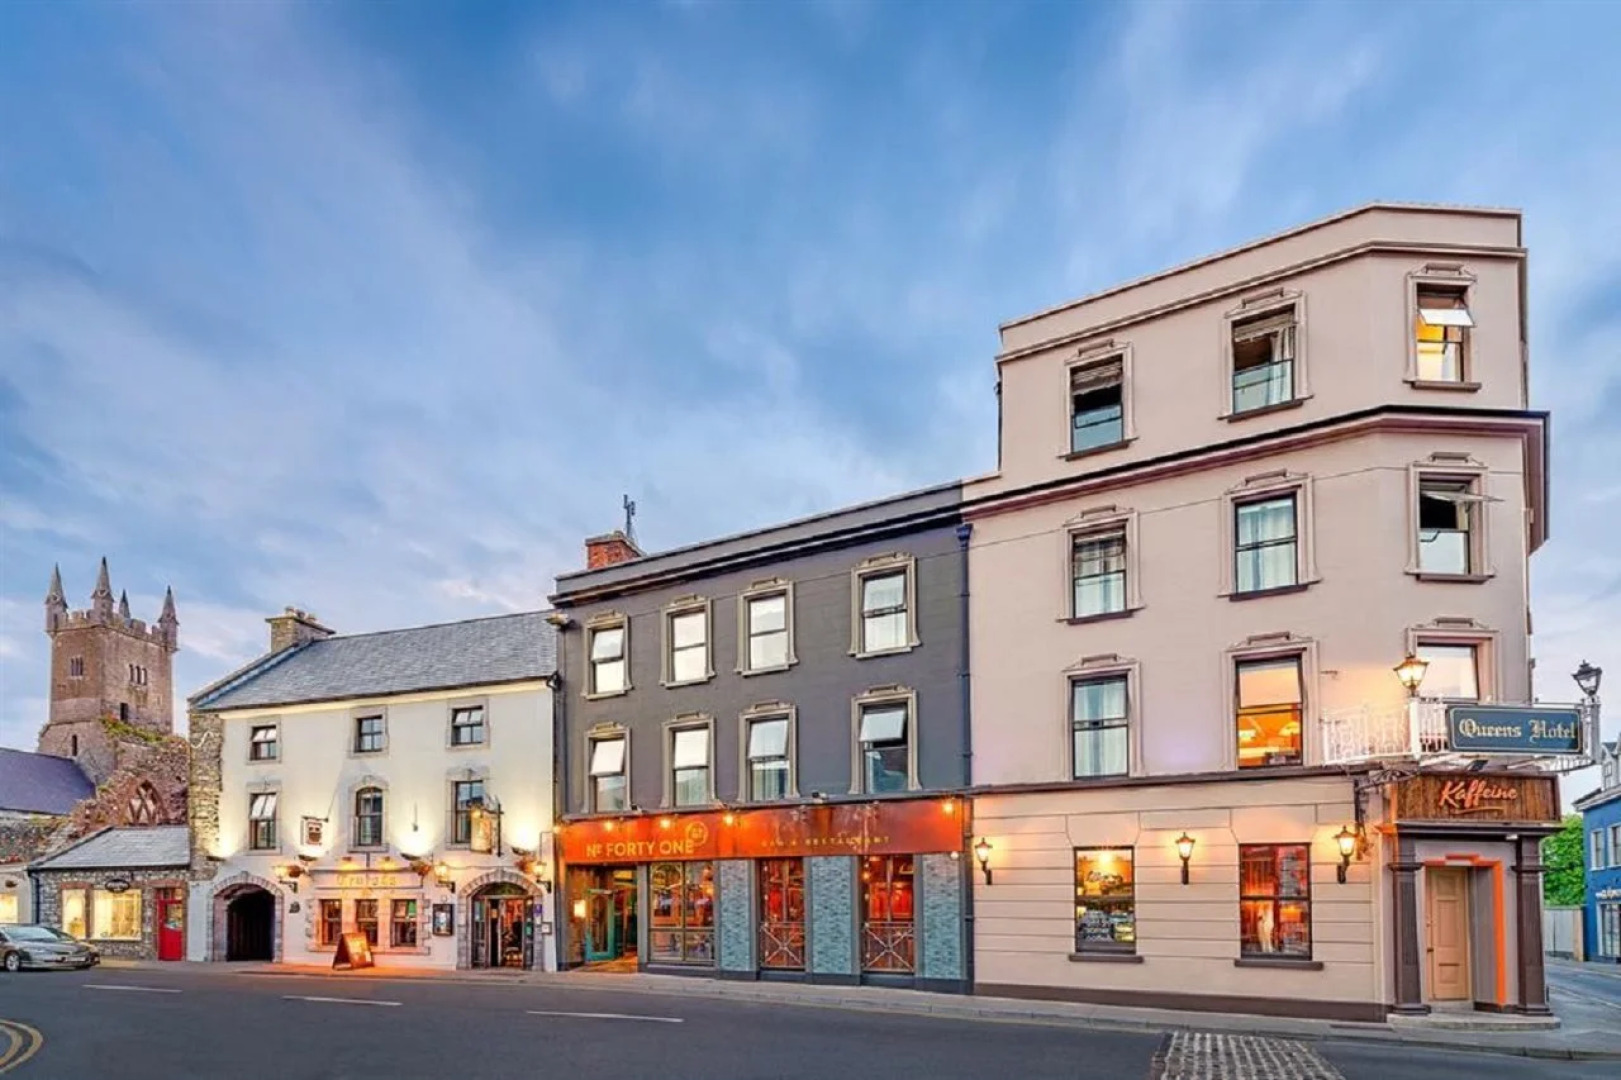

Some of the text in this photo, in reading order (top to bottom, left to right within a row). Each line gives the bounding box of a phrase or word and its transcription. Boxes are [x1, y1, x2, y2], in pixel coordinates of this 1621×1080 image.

[1459, 718, 1576, 743] Queens Hotel
[1438, 779, 1517, 808] Kaffeine
[606, 841, 655, 857] FORTY
[659, 839, 694, 855] ONE
